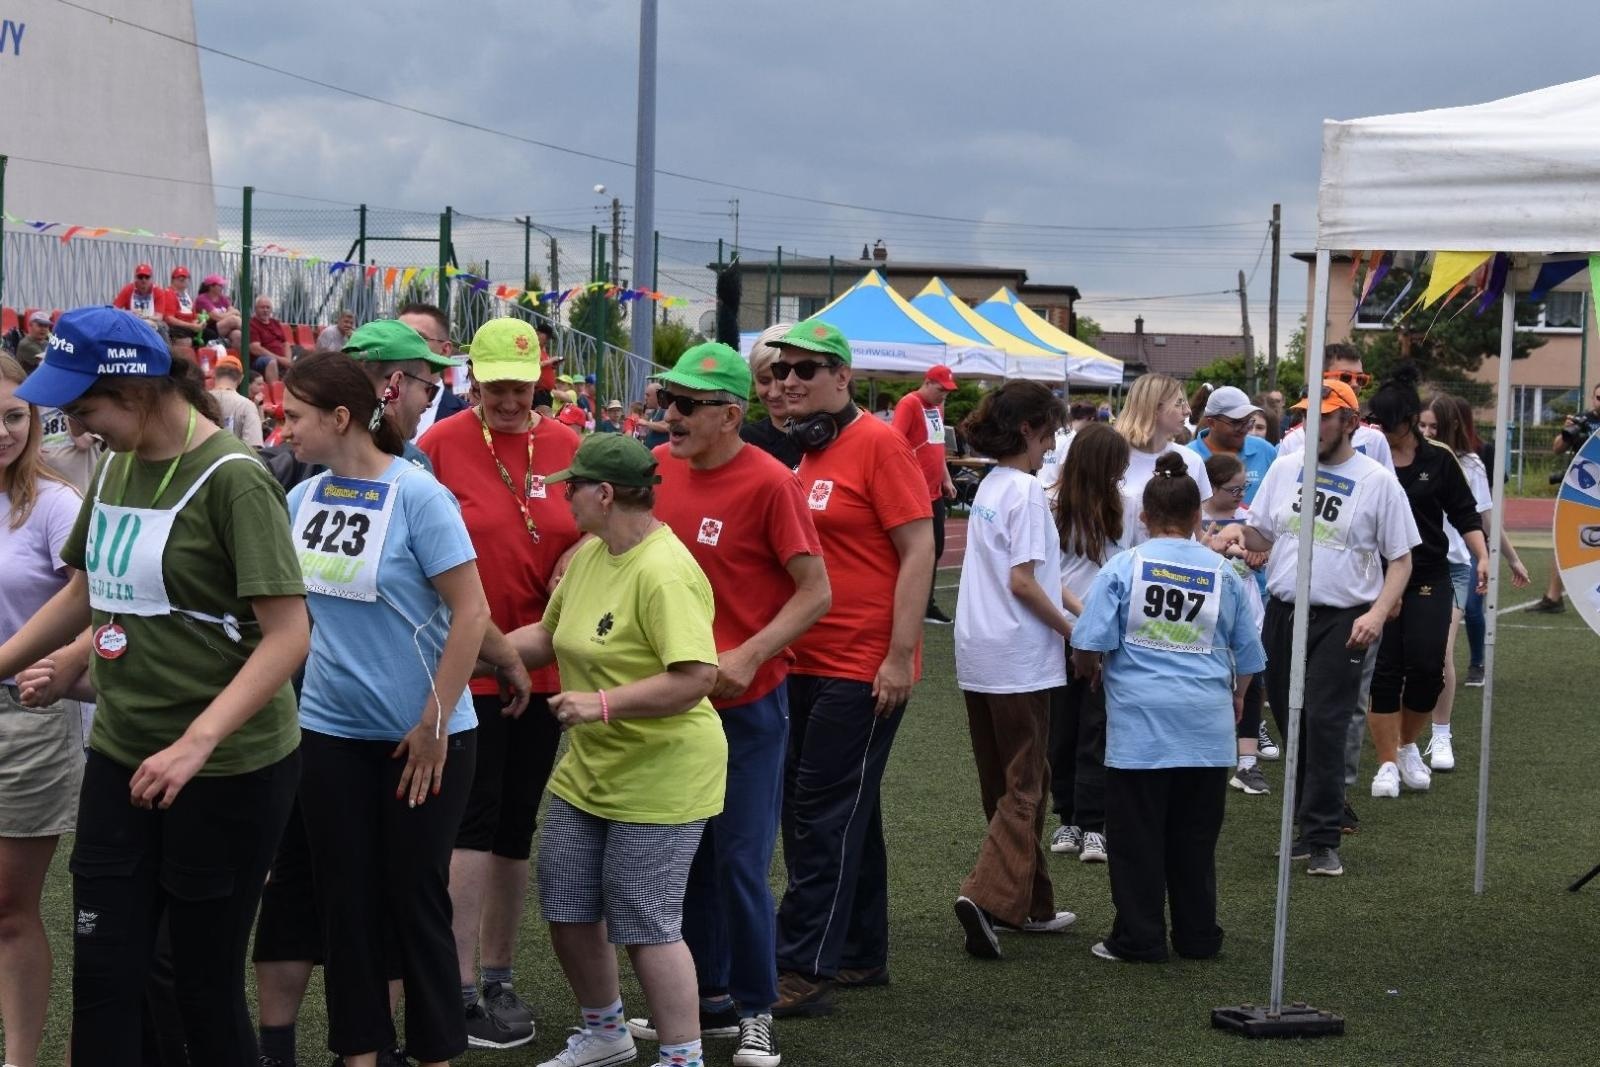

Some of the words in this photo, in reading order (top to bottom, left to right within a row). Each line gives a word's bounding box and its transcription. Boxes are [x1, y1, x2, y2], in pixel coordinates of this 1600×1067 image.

[107, 347, 138, 359] MAM
[97, 362, 147, 375] AUTYZM
[302, 509, 370, 557] 423
[1143, 584, 1206, 623] 997
